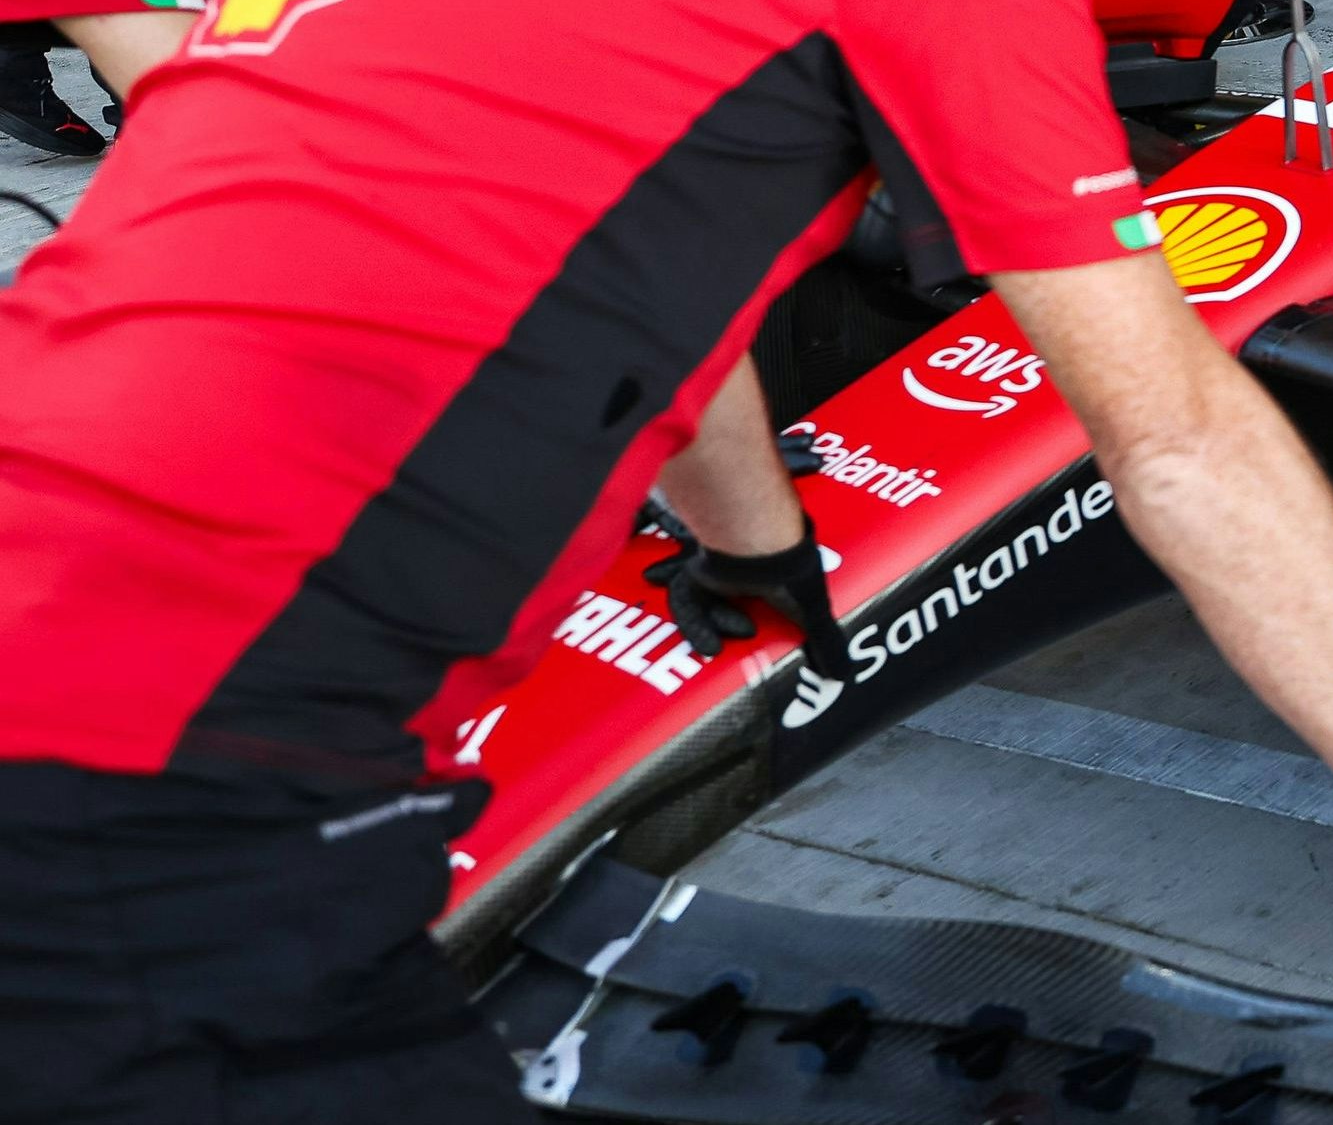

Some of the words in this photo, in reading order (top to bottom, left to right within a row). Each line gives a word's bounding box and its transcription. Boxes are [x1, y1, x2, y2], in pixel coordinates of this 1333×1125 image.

[927, 335, 1046, 393] aws
[811, 432, 942, 507] Palantir
[552, 590, 703, 696] AHLE
